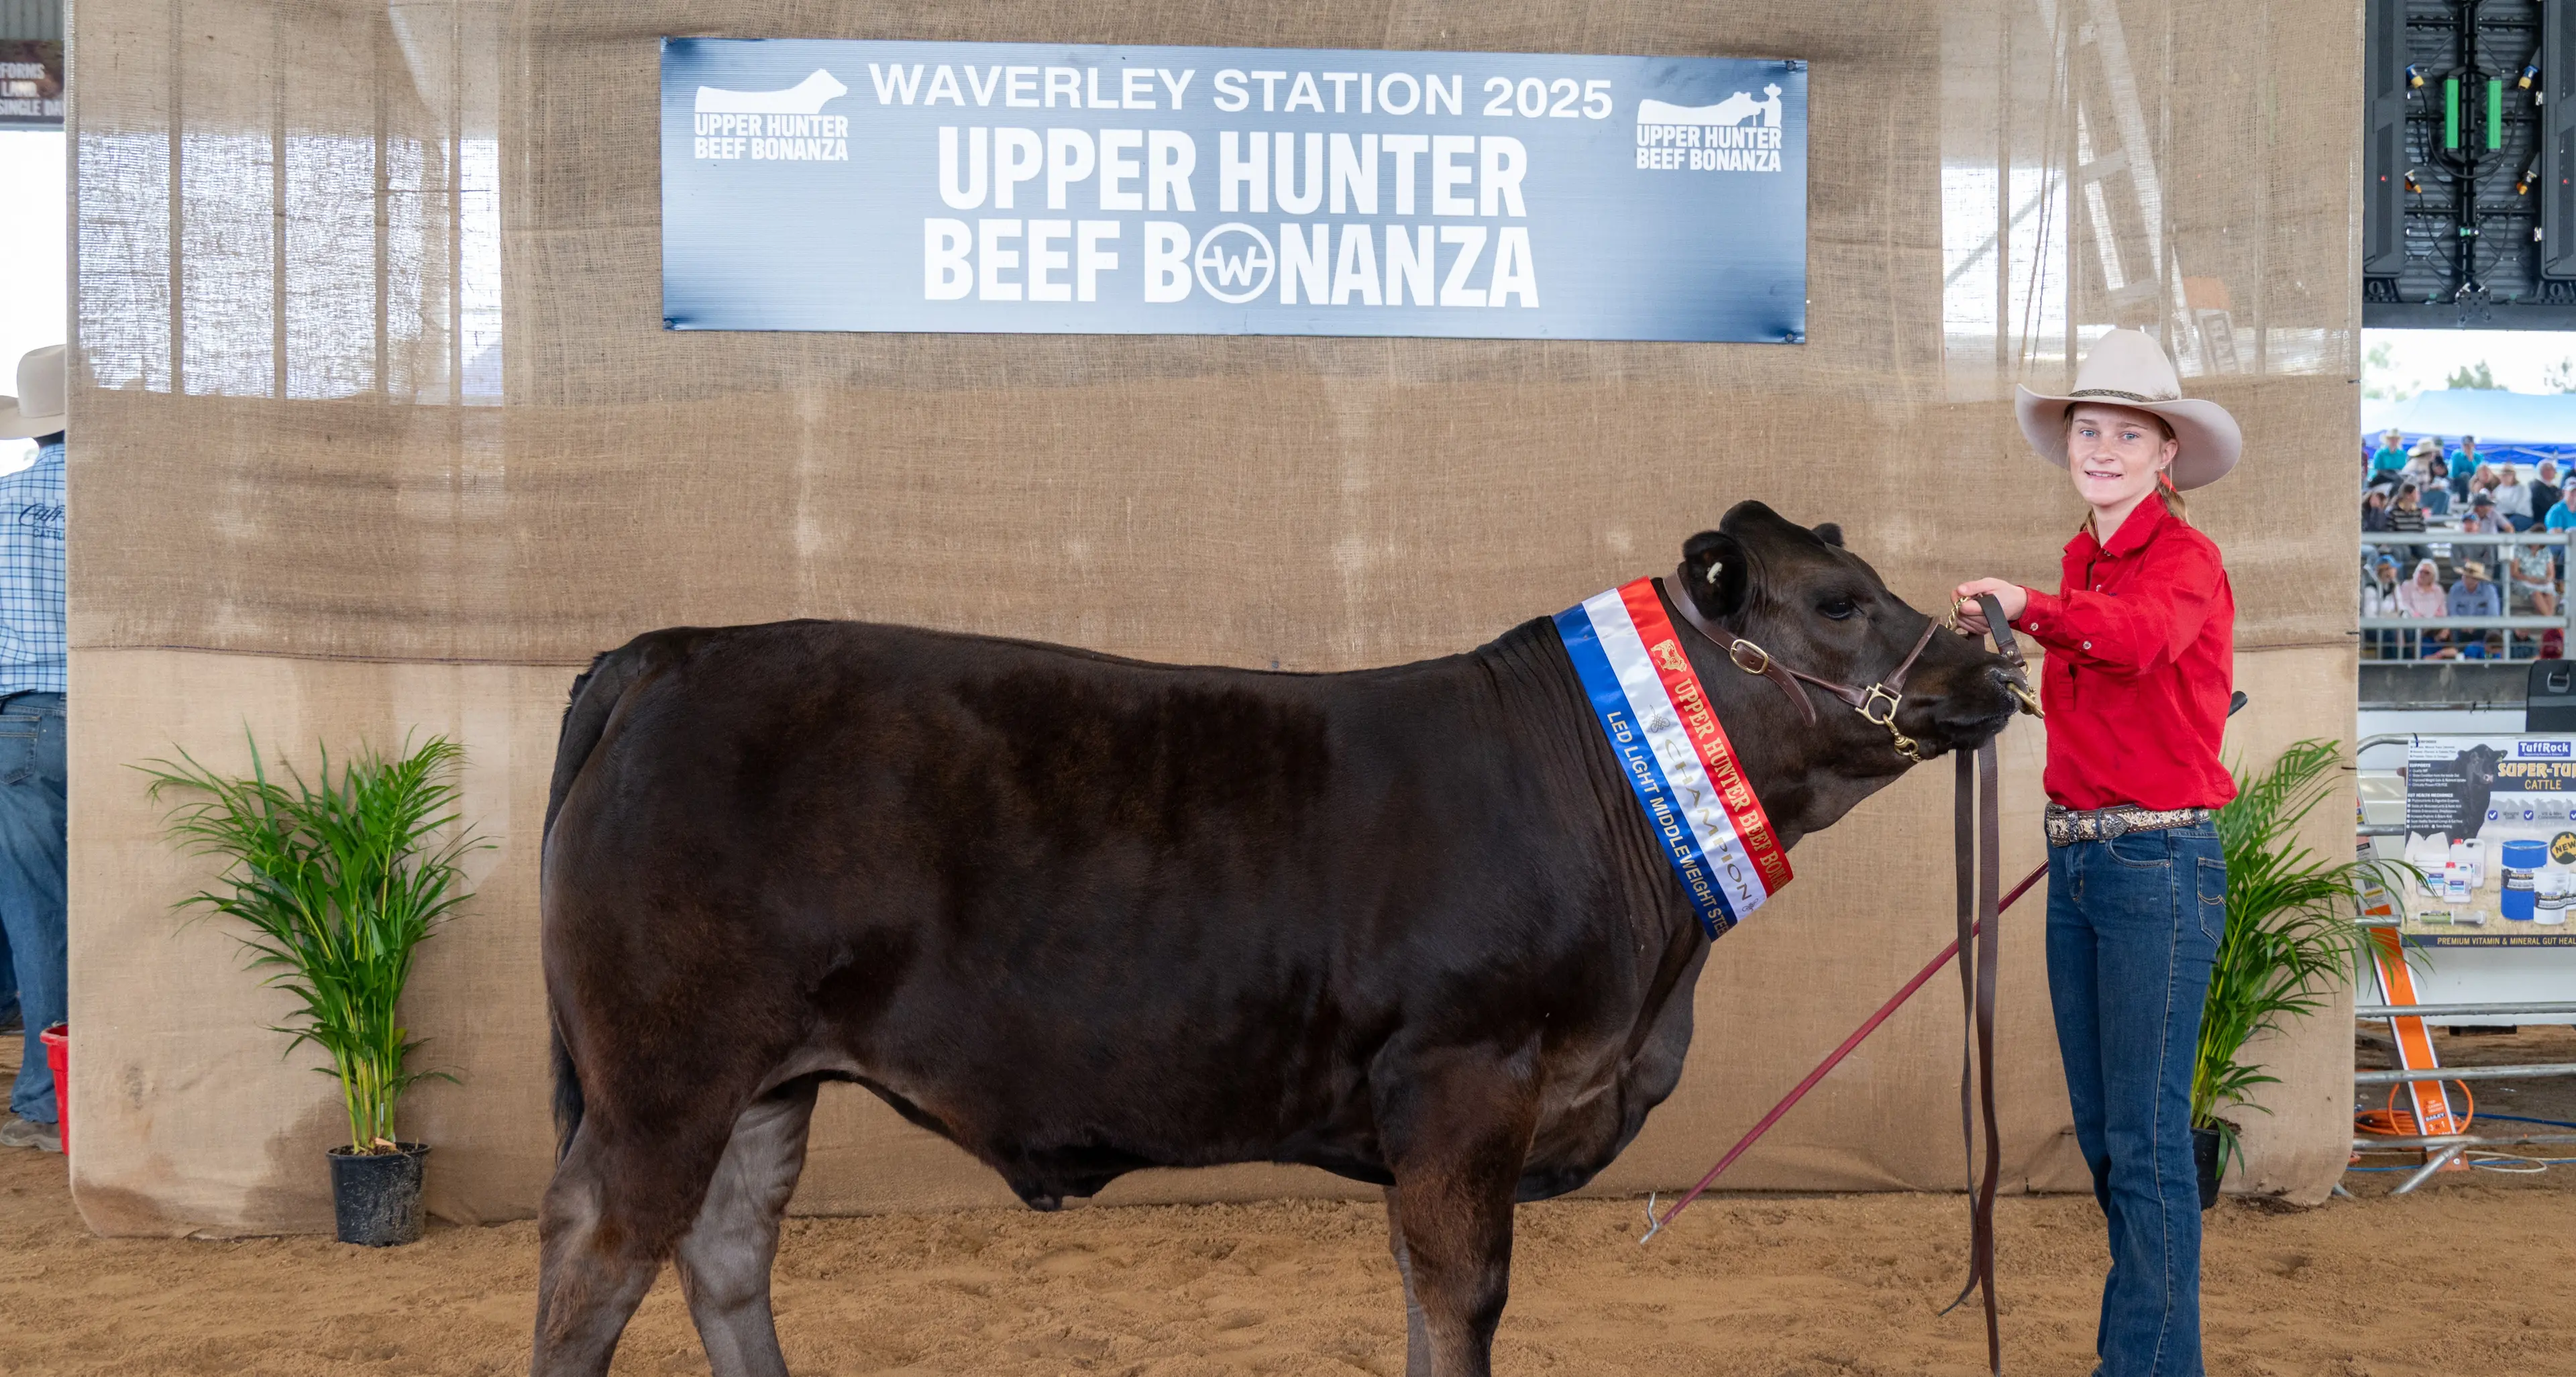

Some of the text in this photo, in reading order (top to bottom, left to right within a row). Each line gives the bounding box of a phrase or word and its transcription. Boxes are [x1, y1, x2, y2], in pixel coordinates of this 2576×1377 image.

[0, 62, 46, 80] FORMS
[868, 63, 1613, 120] WAVERLEY STATION 2025
[695, 113, 849, 137] UPPER HUNTER
[1636, 125, 1782, 149] UPPER HUNTER
[694, 136, 849, 161] BEEF BONANZA
[1636, 148, 1782, 172] BEEF BONANZA
[938, 125, 1527, 217] UPPER HUNTER
[924, 217, 1540, 309] BEEF BONANZA
[2520, 742, 2569, 753] TuffRock
[1674, 677, 1715, 740] UPPER
[1703, 737, 1751, 813] HUNTER
[1739, 810, 1773, 852] BEEF
[2524, 779, 2562, 790] CATTLE
[1607, 711, 1633, 743] LED
[1624, 746, 1660, 793] LIGHT
[1650, 797, 1717, 907] MIDDLEWEIGHT
[1664, 738, 1752, 901] CHAMPION
[2555, 840, 2576, 854] NEW
[2437, 937, 2470, 945] PREMIUM
[2472, 937, 2500, 945] VITAMIN
[2502, 937, 2508, 945] &
[2510, 937, 2540, 945] MINERAL
[2542, 937, 2557, 945] GUT
